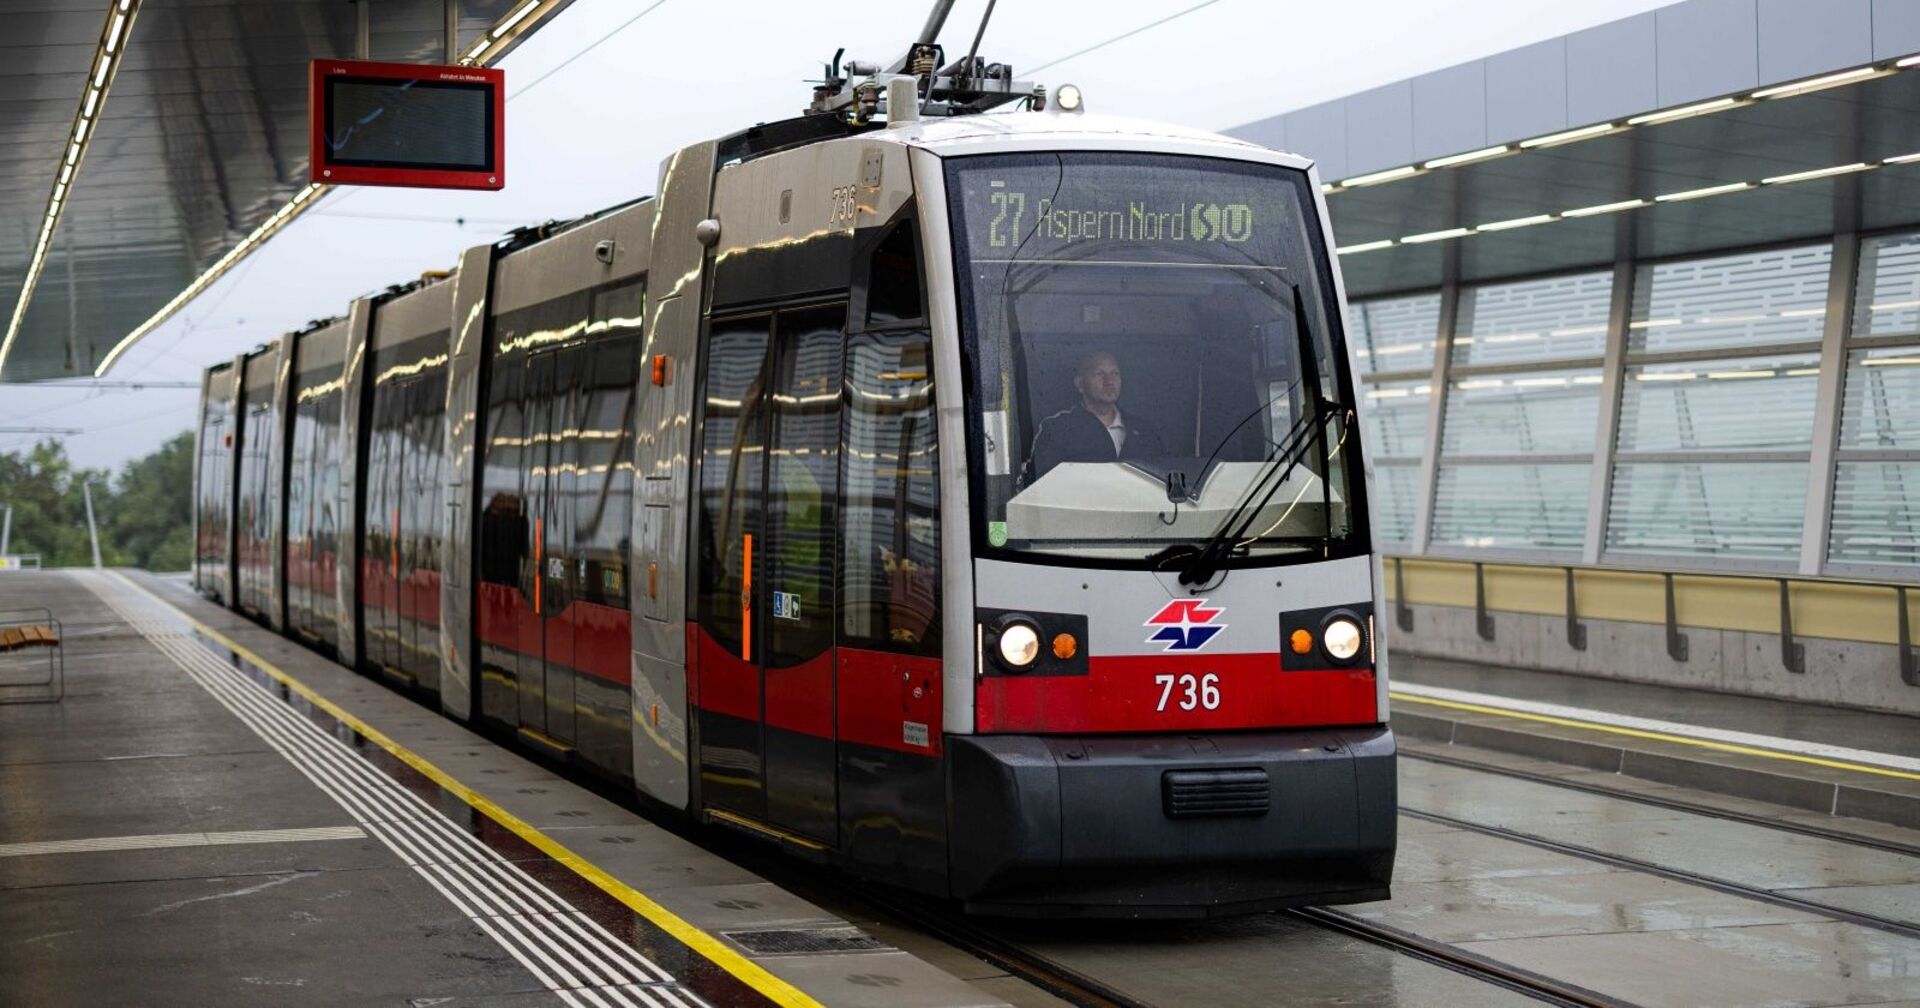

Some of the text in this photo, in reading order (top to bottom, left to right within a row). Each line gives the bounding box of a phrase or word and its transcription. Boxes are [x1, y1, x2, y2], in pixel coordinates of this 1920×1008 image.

[830, 184, 857, 223] 736
[990, 192, 1025, 247] 27
[1038, 199, 1123, 243] Aspern
[1129, 201, 1185, 241] Nord
[1155, 673, 1220, 711] 736
